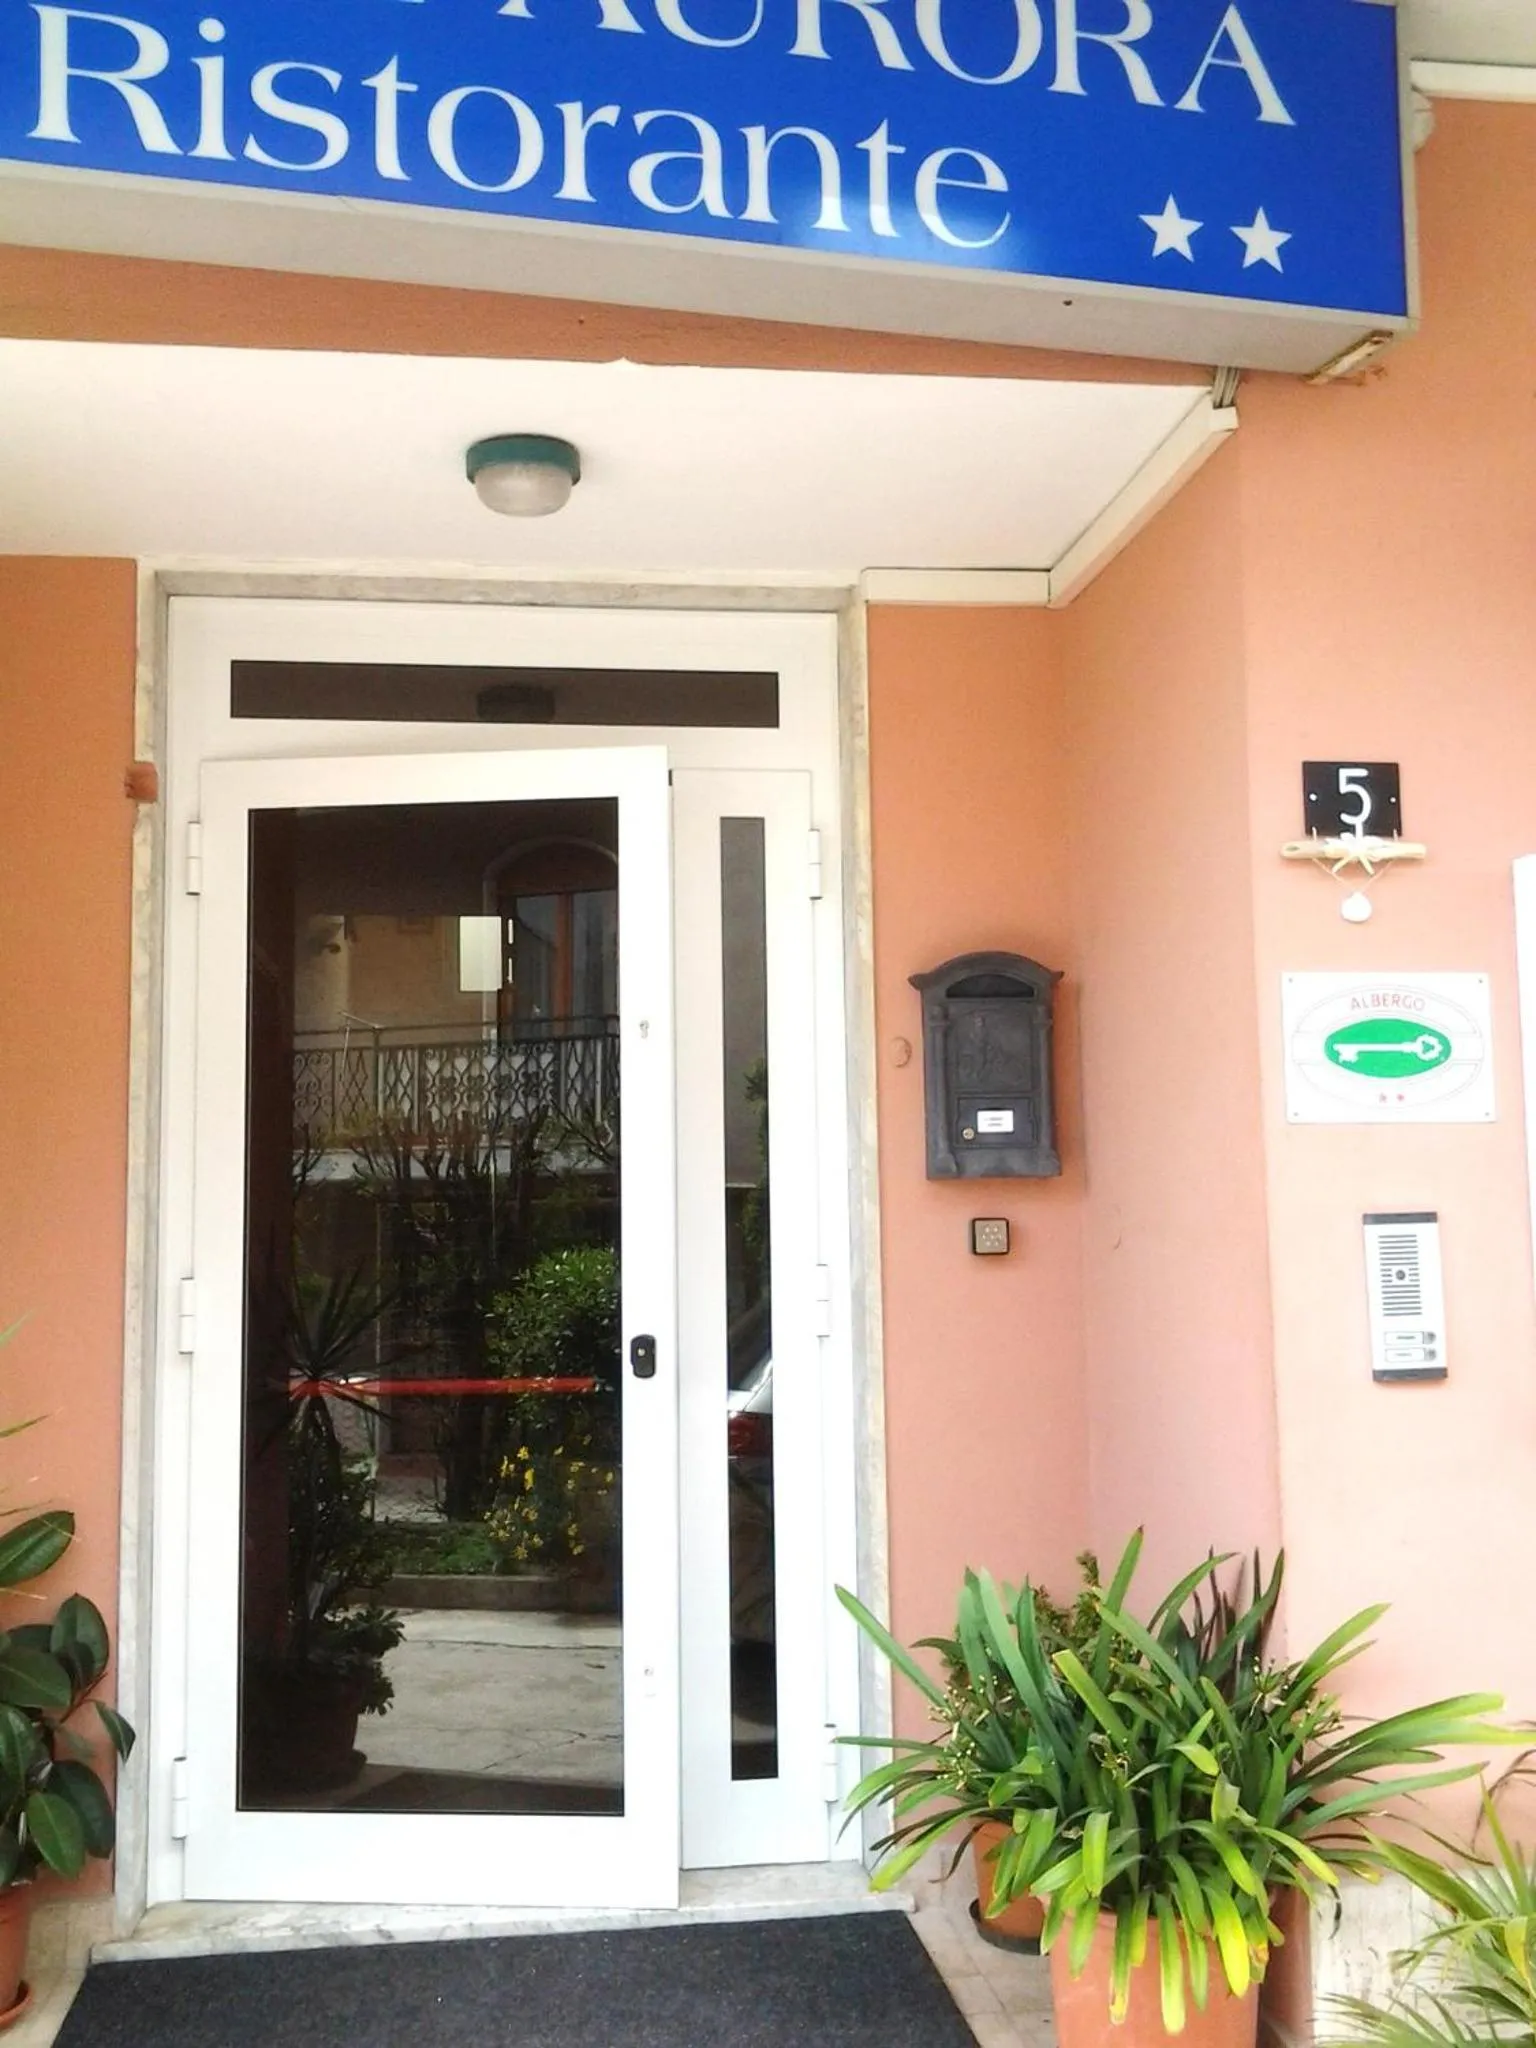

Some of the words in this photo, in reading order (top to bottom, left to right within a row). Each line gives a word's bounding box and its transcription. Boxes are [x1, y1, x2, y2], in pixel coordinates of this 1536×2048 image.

[497, 0, 1296, 126] RORA
[27, 4, 1011, 249] Ristorante
[1338, 767, 1372, 824] 5
[1350, 991, 1426, 1012] ALBERGO
